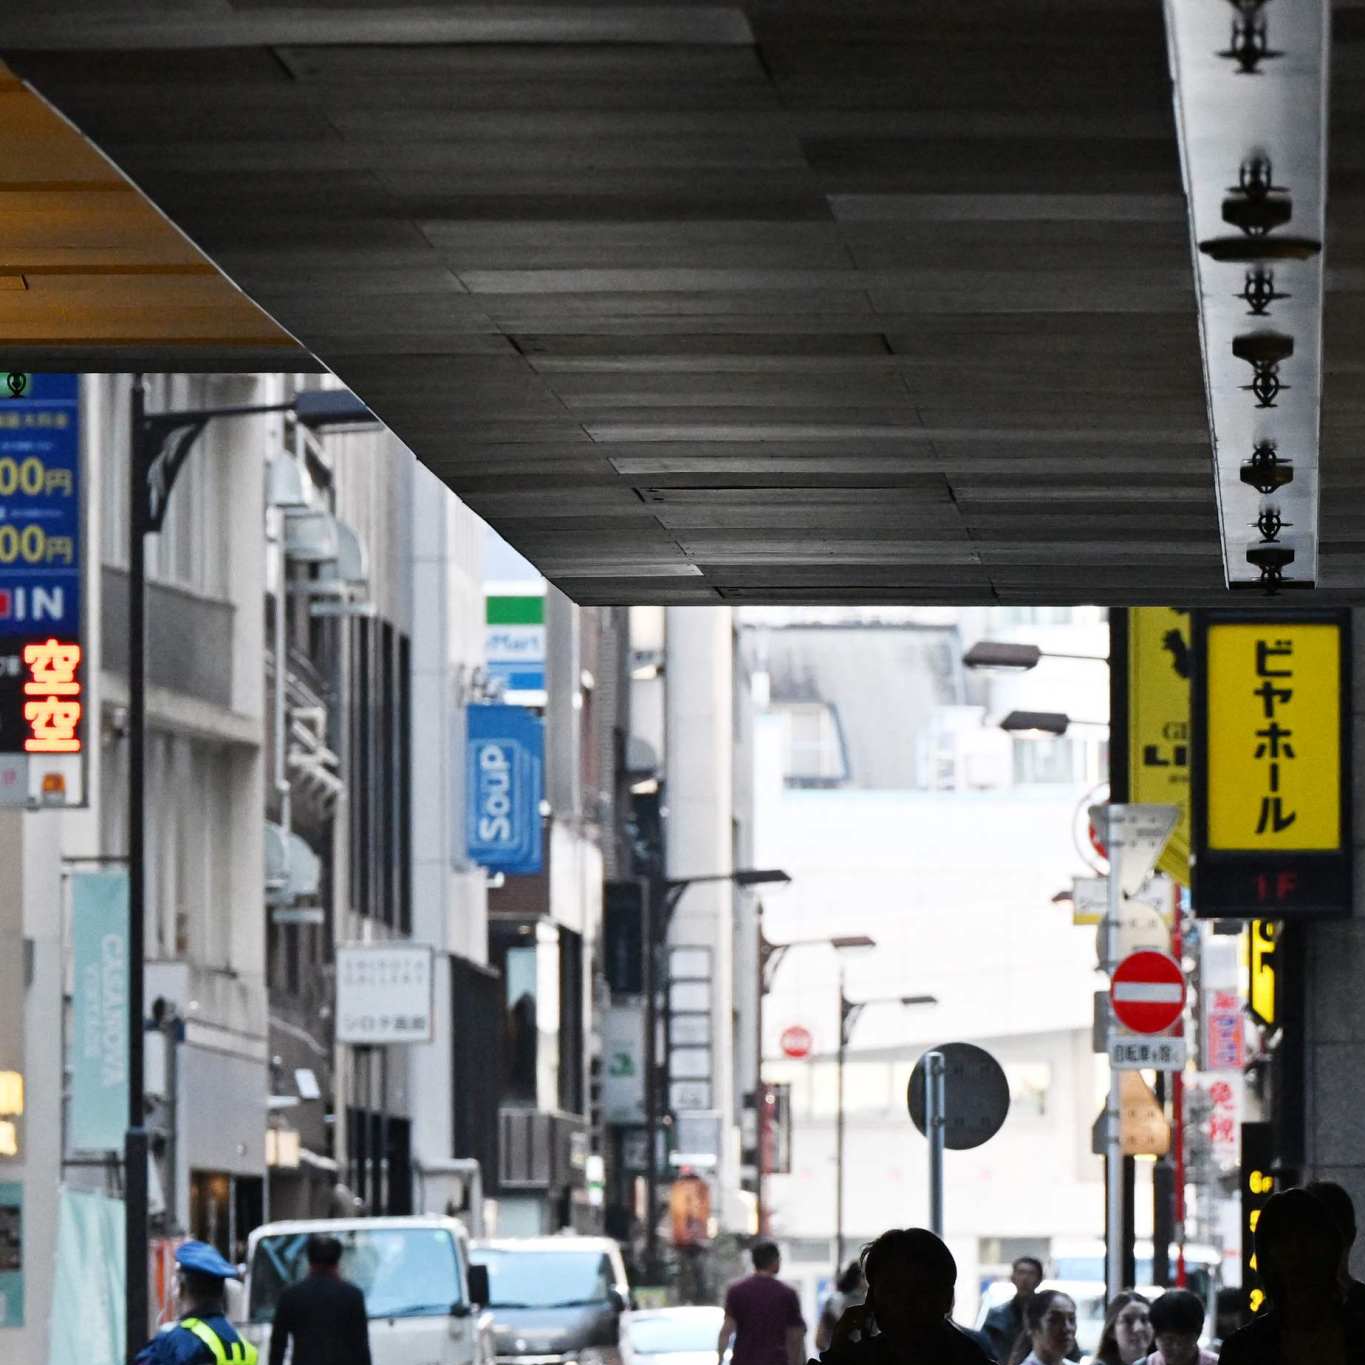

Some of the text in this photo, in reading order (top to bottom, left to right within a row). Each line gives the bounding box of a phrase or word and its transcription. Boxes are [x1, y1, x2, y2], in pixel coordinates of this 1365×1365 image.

[24, 640, 81, 695] 空
[24, 697, 81, 753] 空
[1254, 639, 1296, 836] ビヤホール
[480, 744, 511, 840] Soup
[1257, 872, 1298, 898] 1F
